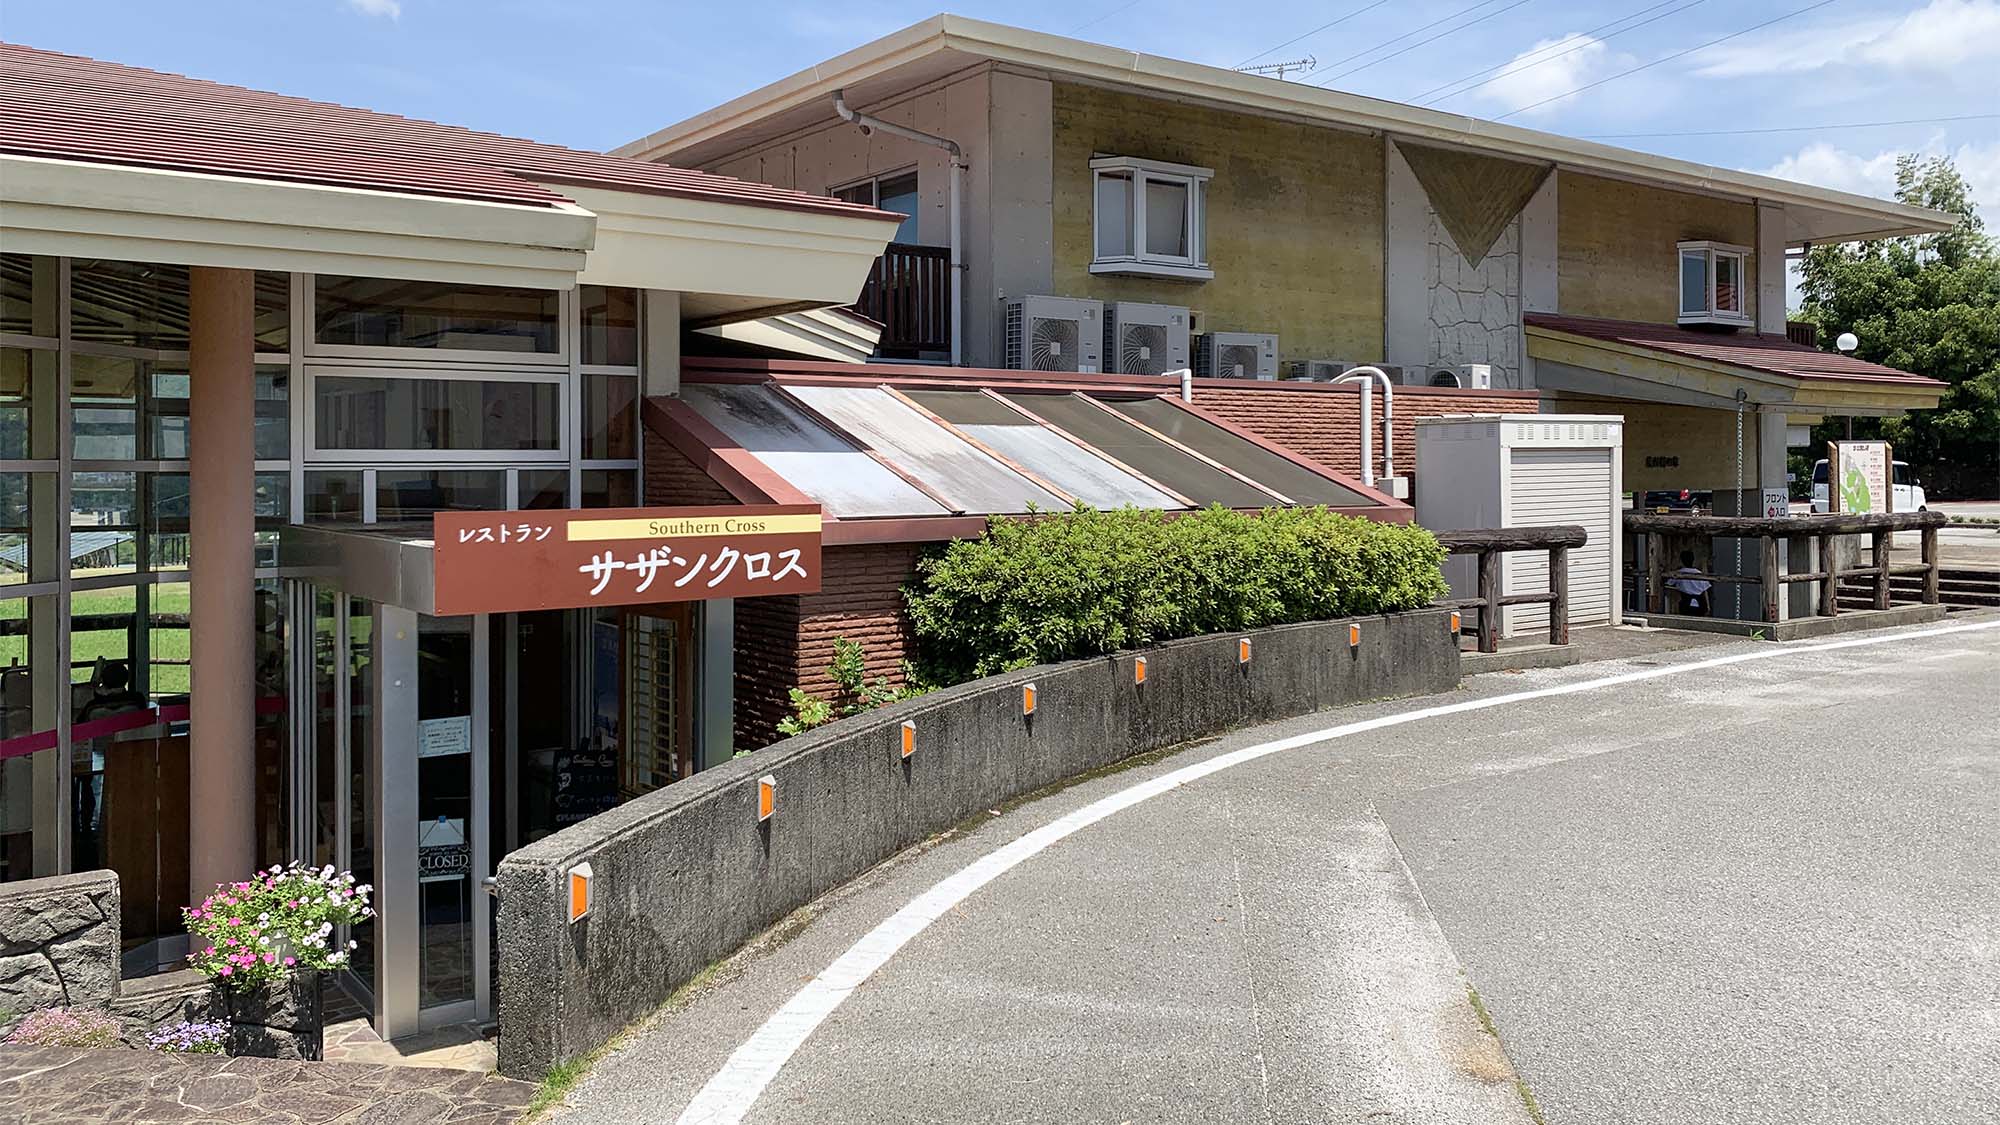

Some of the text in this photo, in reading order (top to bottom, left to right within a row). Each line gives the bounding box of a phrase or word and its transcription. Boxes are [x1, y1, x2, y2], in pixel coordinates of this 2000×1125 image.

[1765, 493, 1787, 504] フロント
[458, 523, 552, 544] レストラン
[648, 518, 766, 535] Southern Cross
[579, 545, 808, 596] サザンクロス
[419, 854, 469, 869] CLOSED
